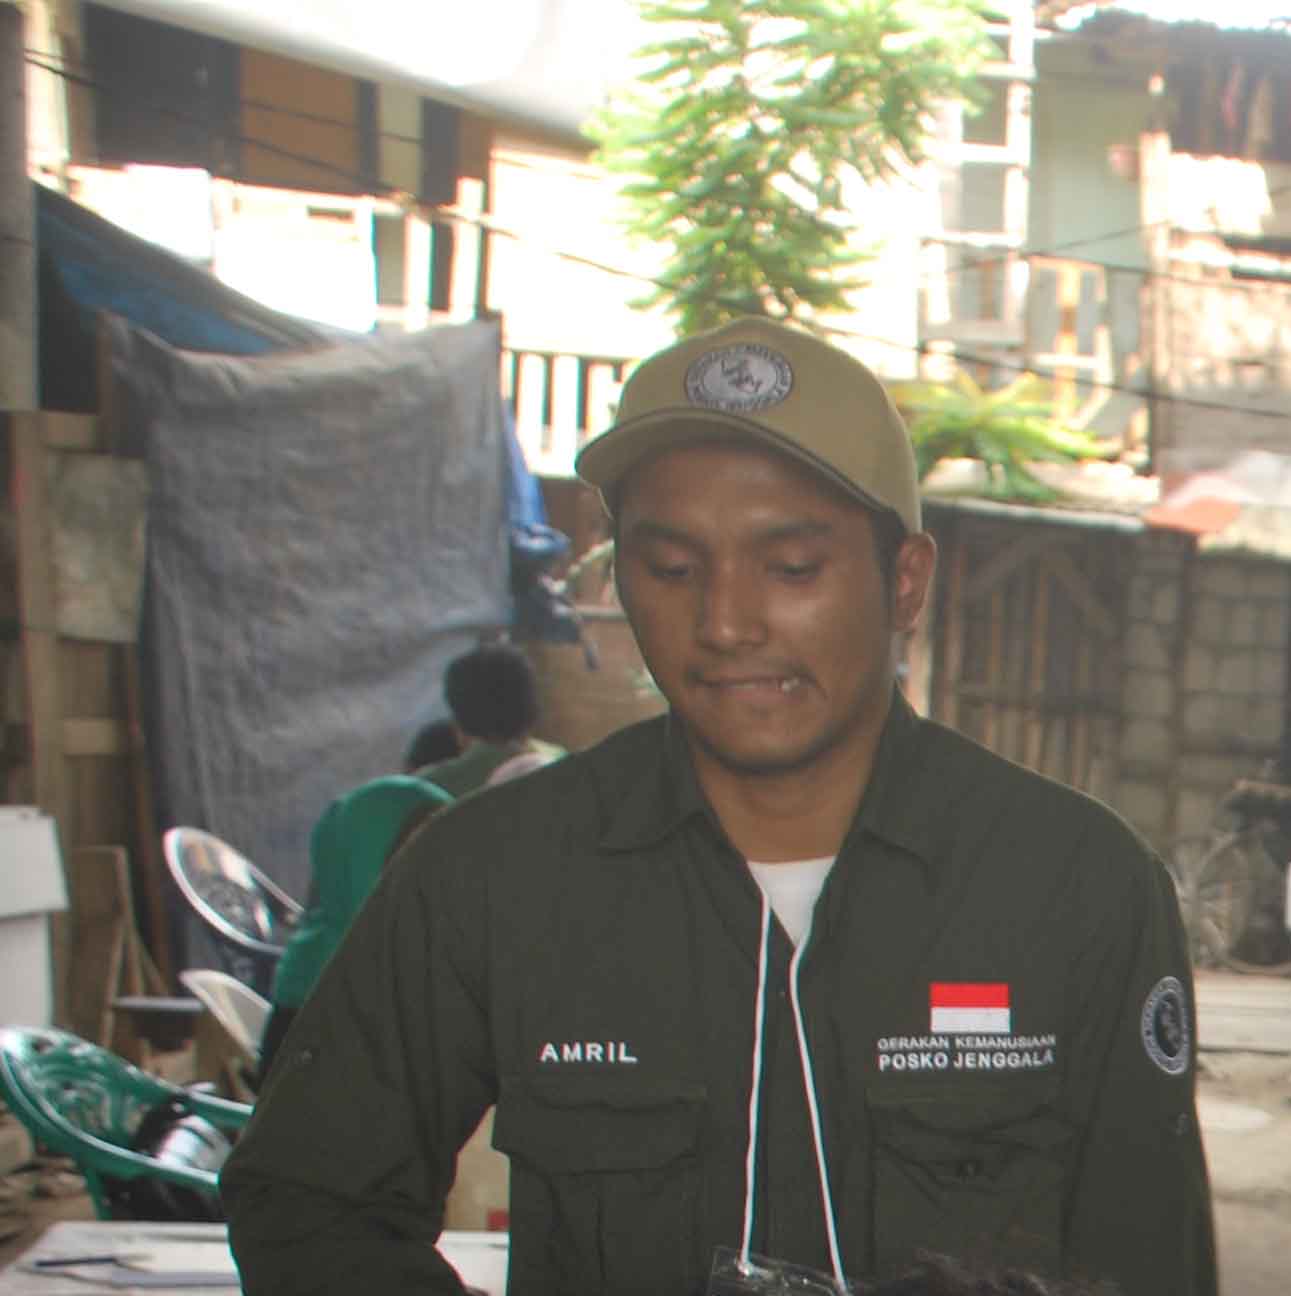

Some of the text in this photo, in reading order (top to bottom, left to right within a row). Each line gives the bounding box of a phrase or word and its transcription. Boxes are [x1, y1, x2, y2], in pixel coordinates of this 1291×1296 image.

[539, 1041, 639, 1063] AMRIL
[877, 1034, 1056, 1050] GERAKAN KEMANUSIAAN
[878, 1050, 1054, 1071] POSKO JENGGALA
